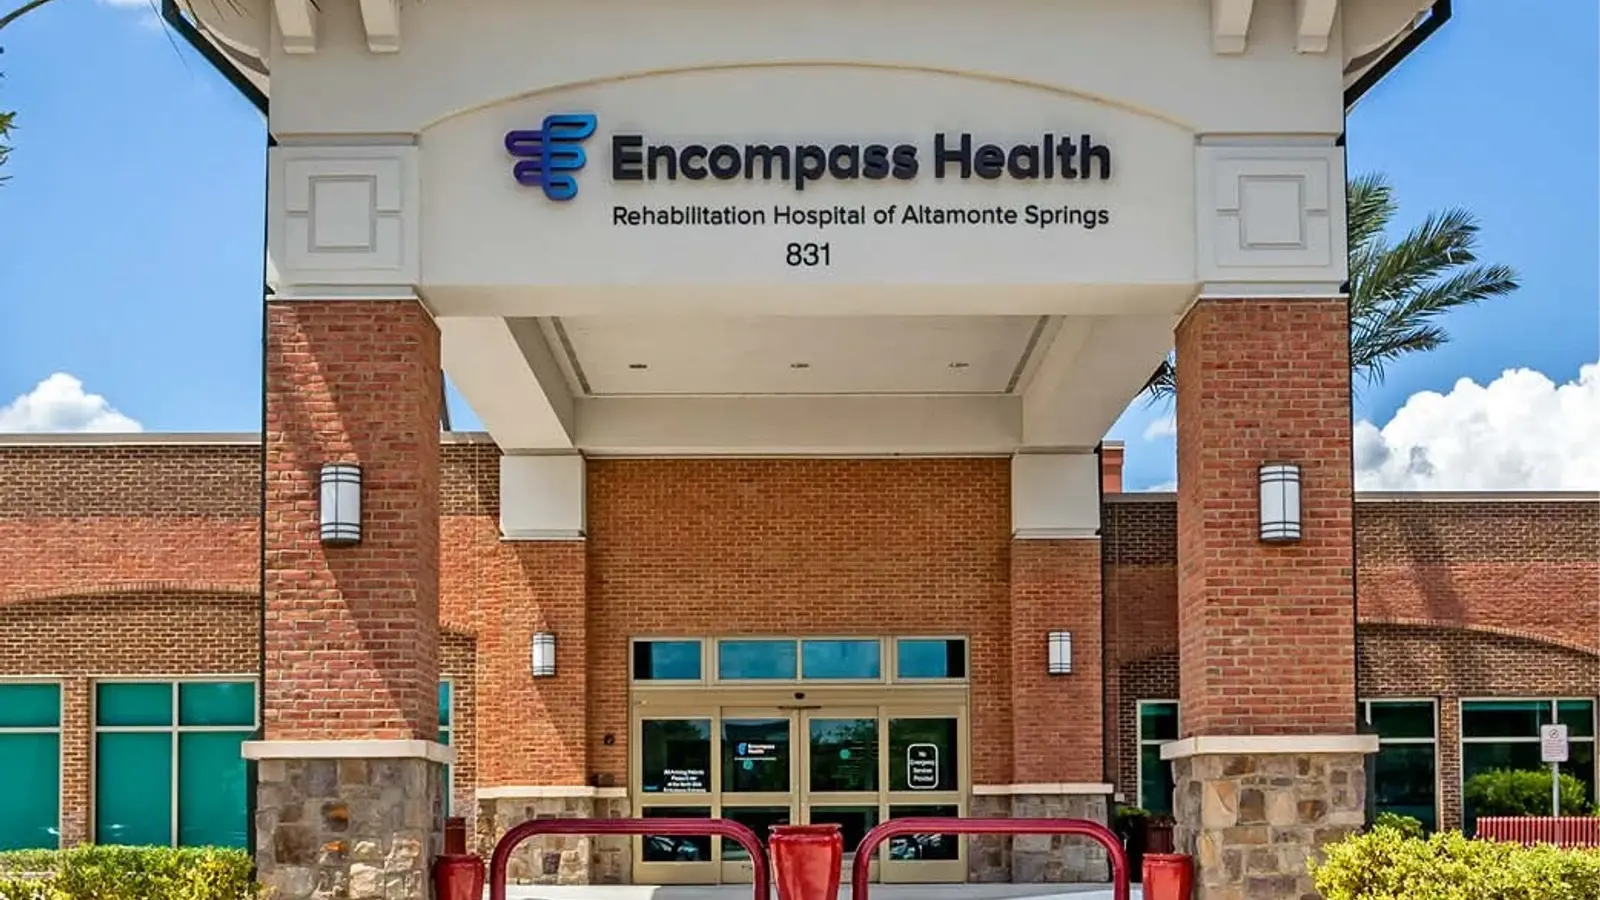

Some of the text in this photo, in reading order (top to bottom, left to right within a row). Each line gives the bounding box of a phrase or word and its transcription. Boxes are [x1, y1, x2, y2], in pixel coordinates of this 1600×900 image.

[612, 132, 1111, 192] Encompass Health
[612, 204, 1110, 230] Rehabilitation Hospital of Altamonte Springs
[785, 242, 830, 267] 831
